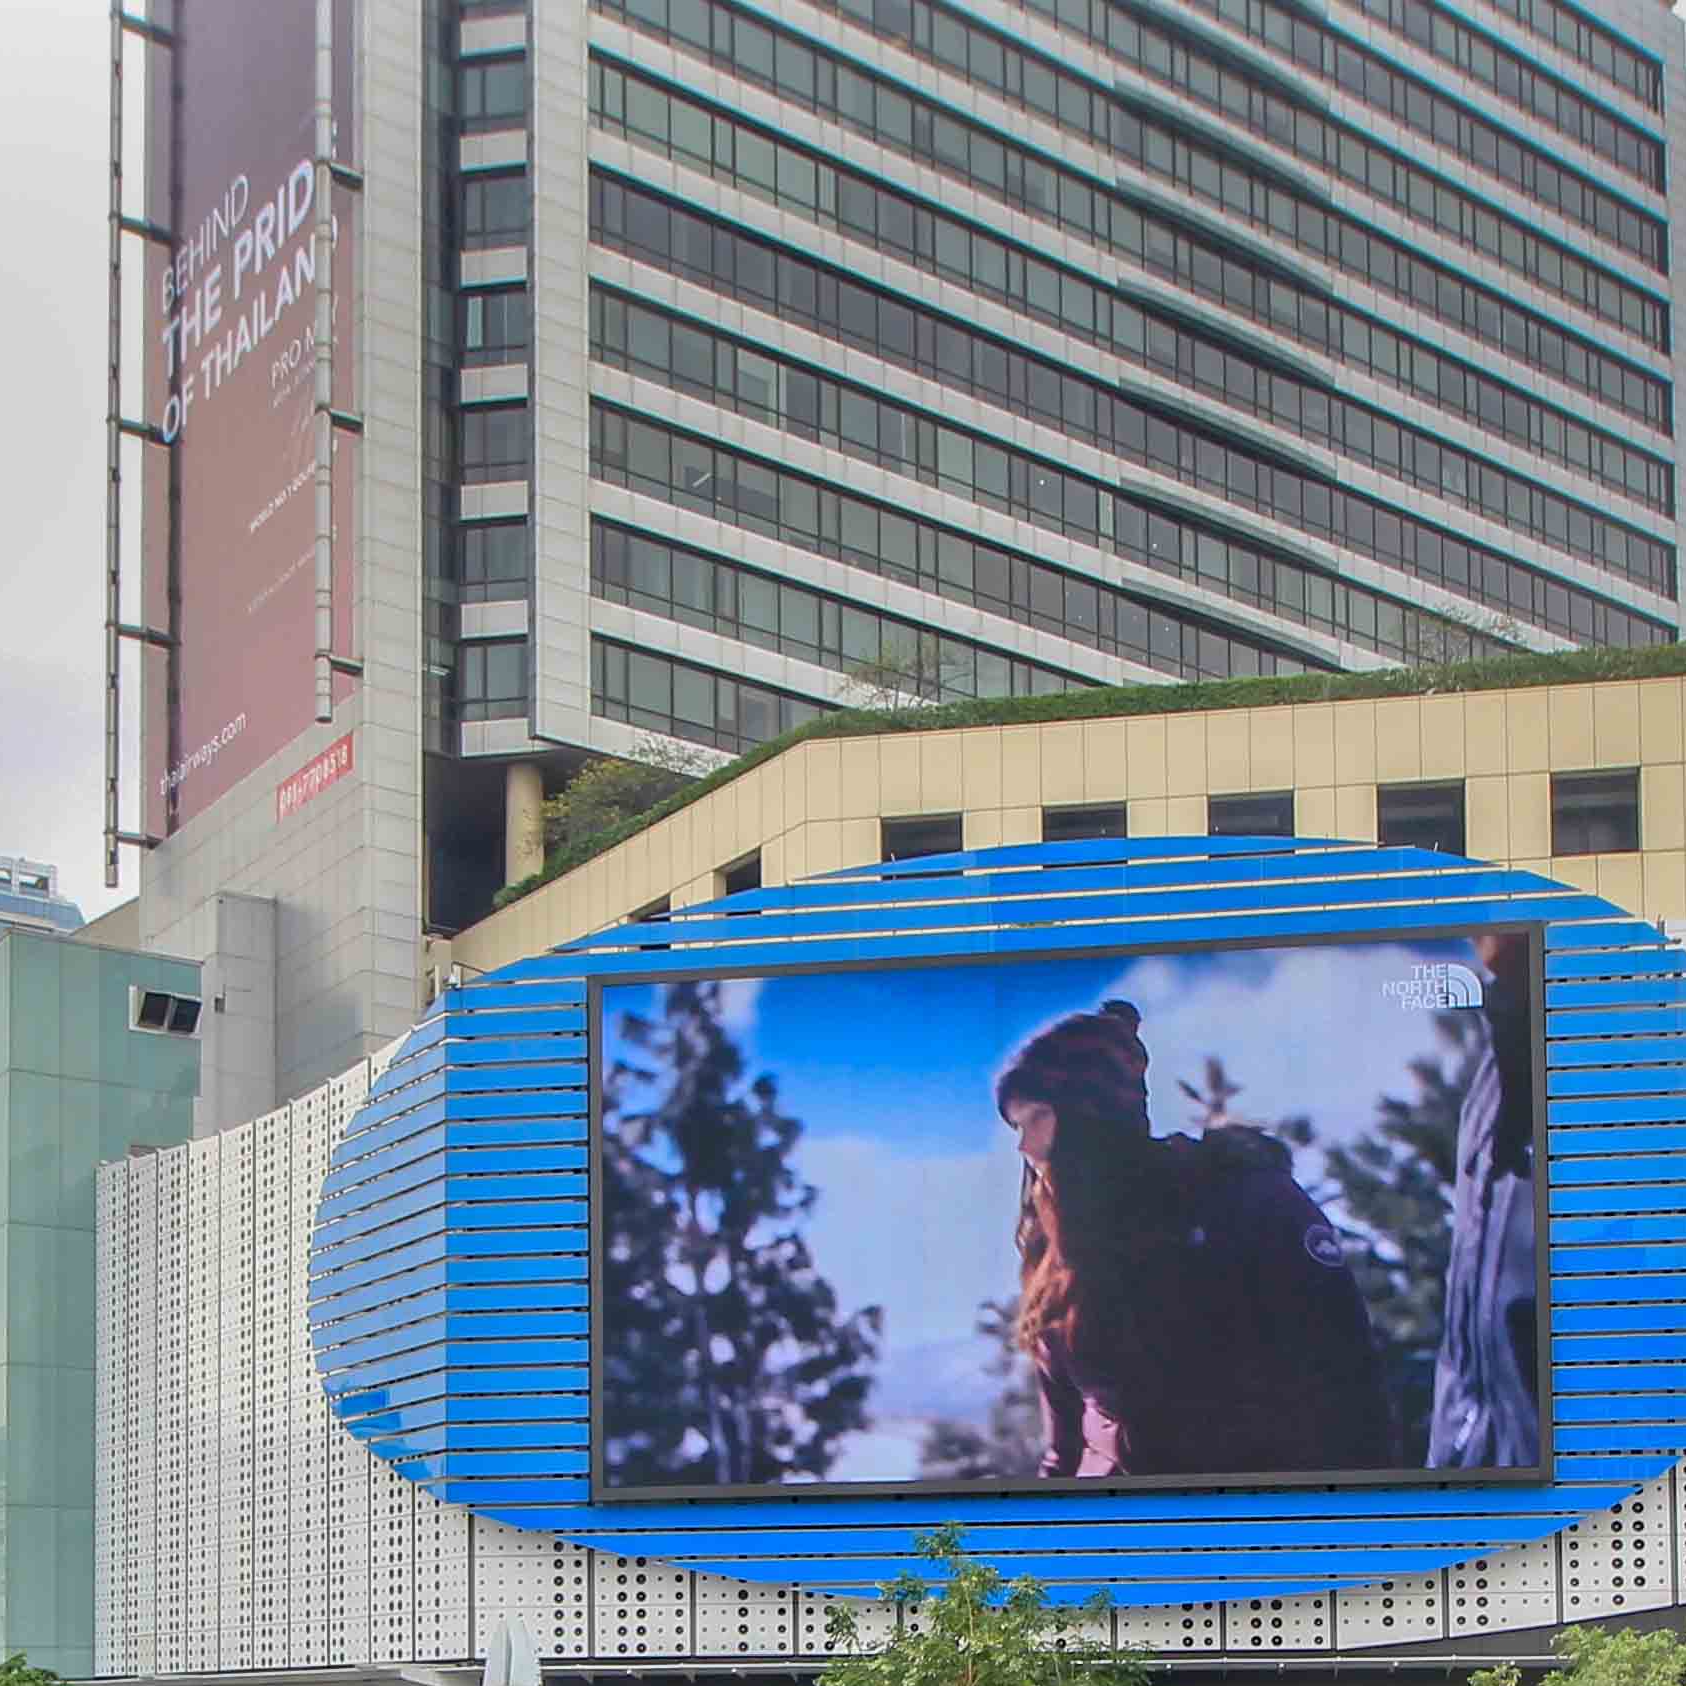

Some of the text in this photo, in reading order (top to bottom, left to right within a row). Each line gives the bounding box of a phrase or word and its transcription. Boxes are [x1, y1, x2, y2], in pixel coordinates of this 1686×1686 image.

[163, 174, 250, 315] BEHIND
[162, 263, 223, 379] THE
[162, 376, 195, 444] OF
[1381, 980, 1447, 996] NORTH
[1411, 964, 1447, 978] THE
[1403, 995, 1449, 1010] FACE
